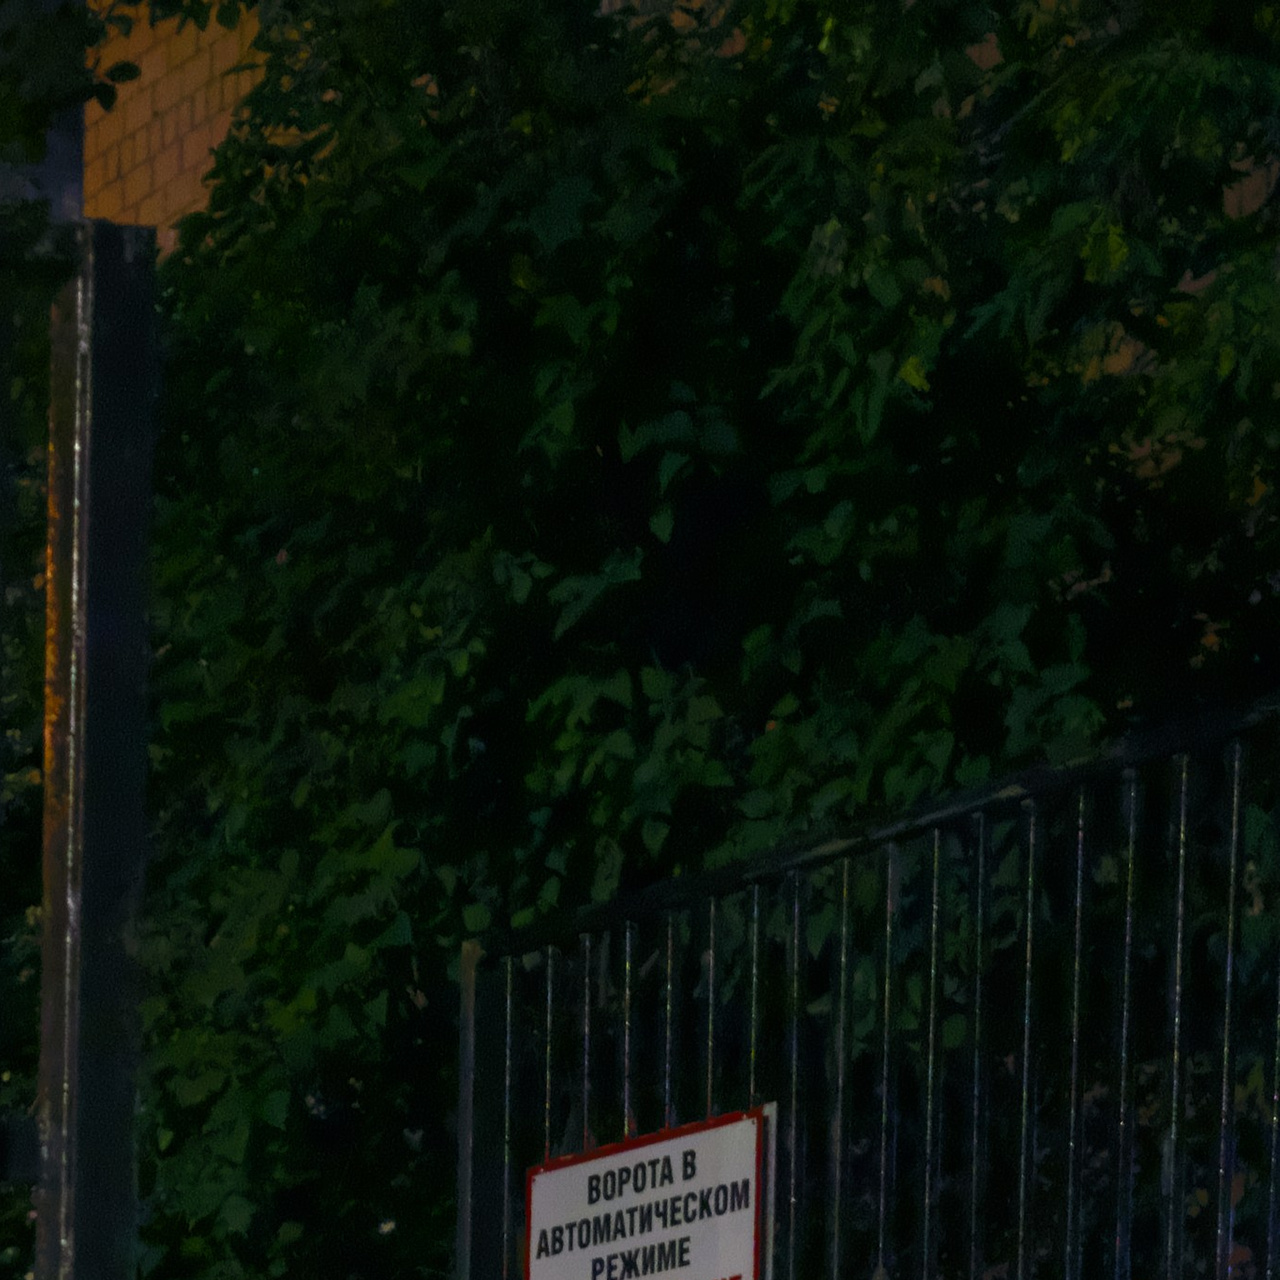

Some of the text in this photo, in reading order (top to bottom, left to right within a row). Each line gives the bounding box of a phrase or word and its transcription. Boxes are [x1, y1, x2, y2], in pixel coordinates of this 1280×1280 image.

[587, 1149, 697, 1205] ВОРОТА В
[536, 1178, 750, 1260] АВТОМАТИЧЕСКОМ
